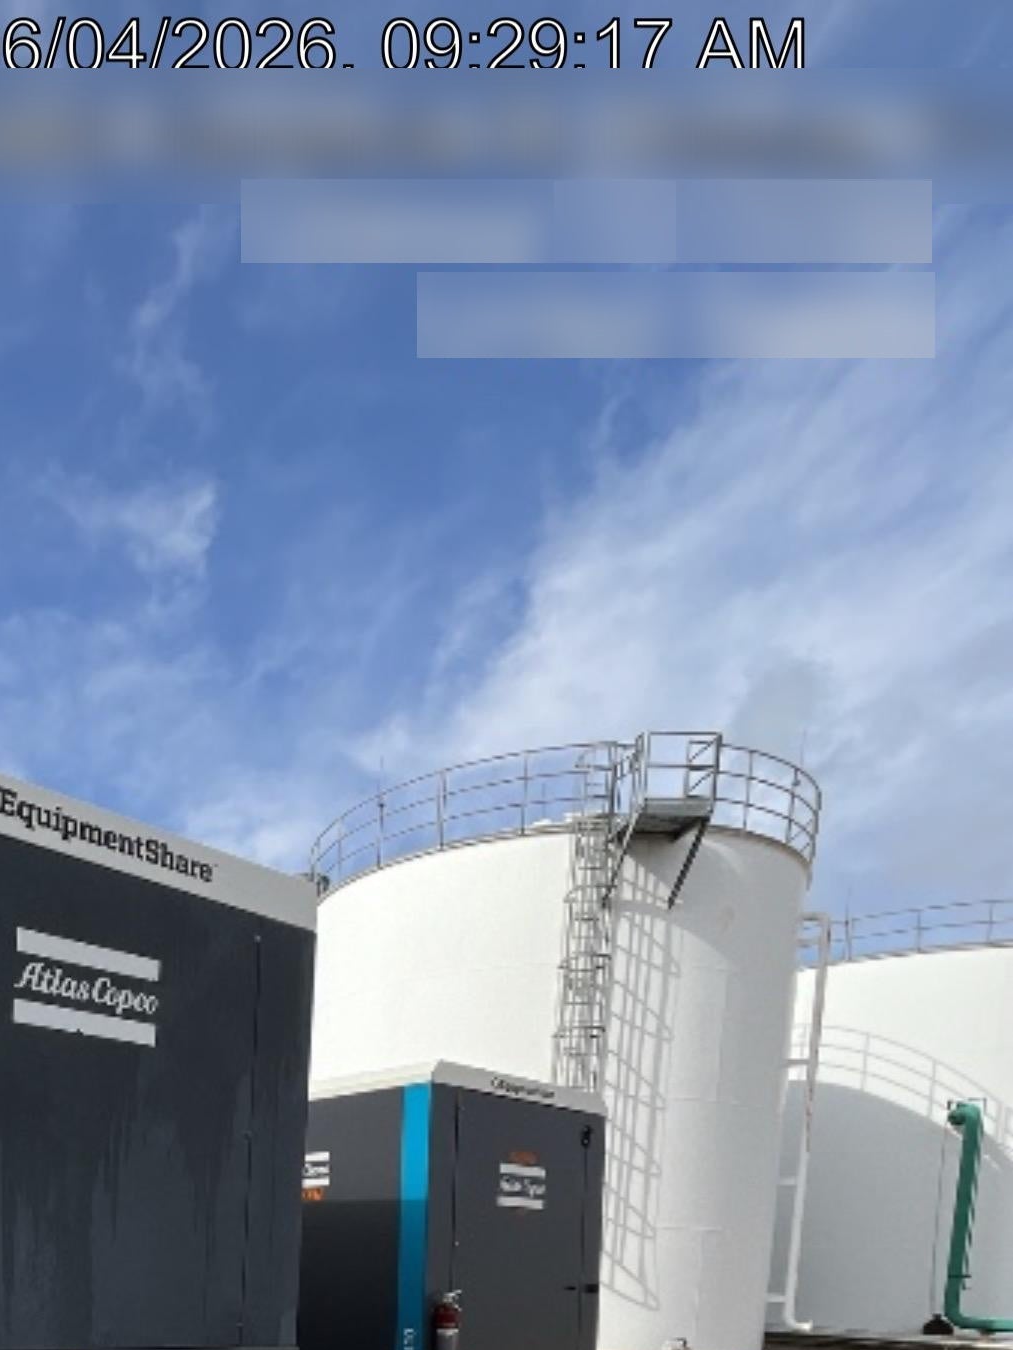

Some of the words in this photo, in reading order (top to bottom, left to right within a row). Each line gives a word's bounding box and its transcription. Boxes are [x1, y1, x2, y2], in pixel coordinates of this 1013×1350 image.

[0, 786, 213, 882] EquipmentShare
[14, 962, 89, 1001] Atlas
[92, 977, 159, 1015] Copco
